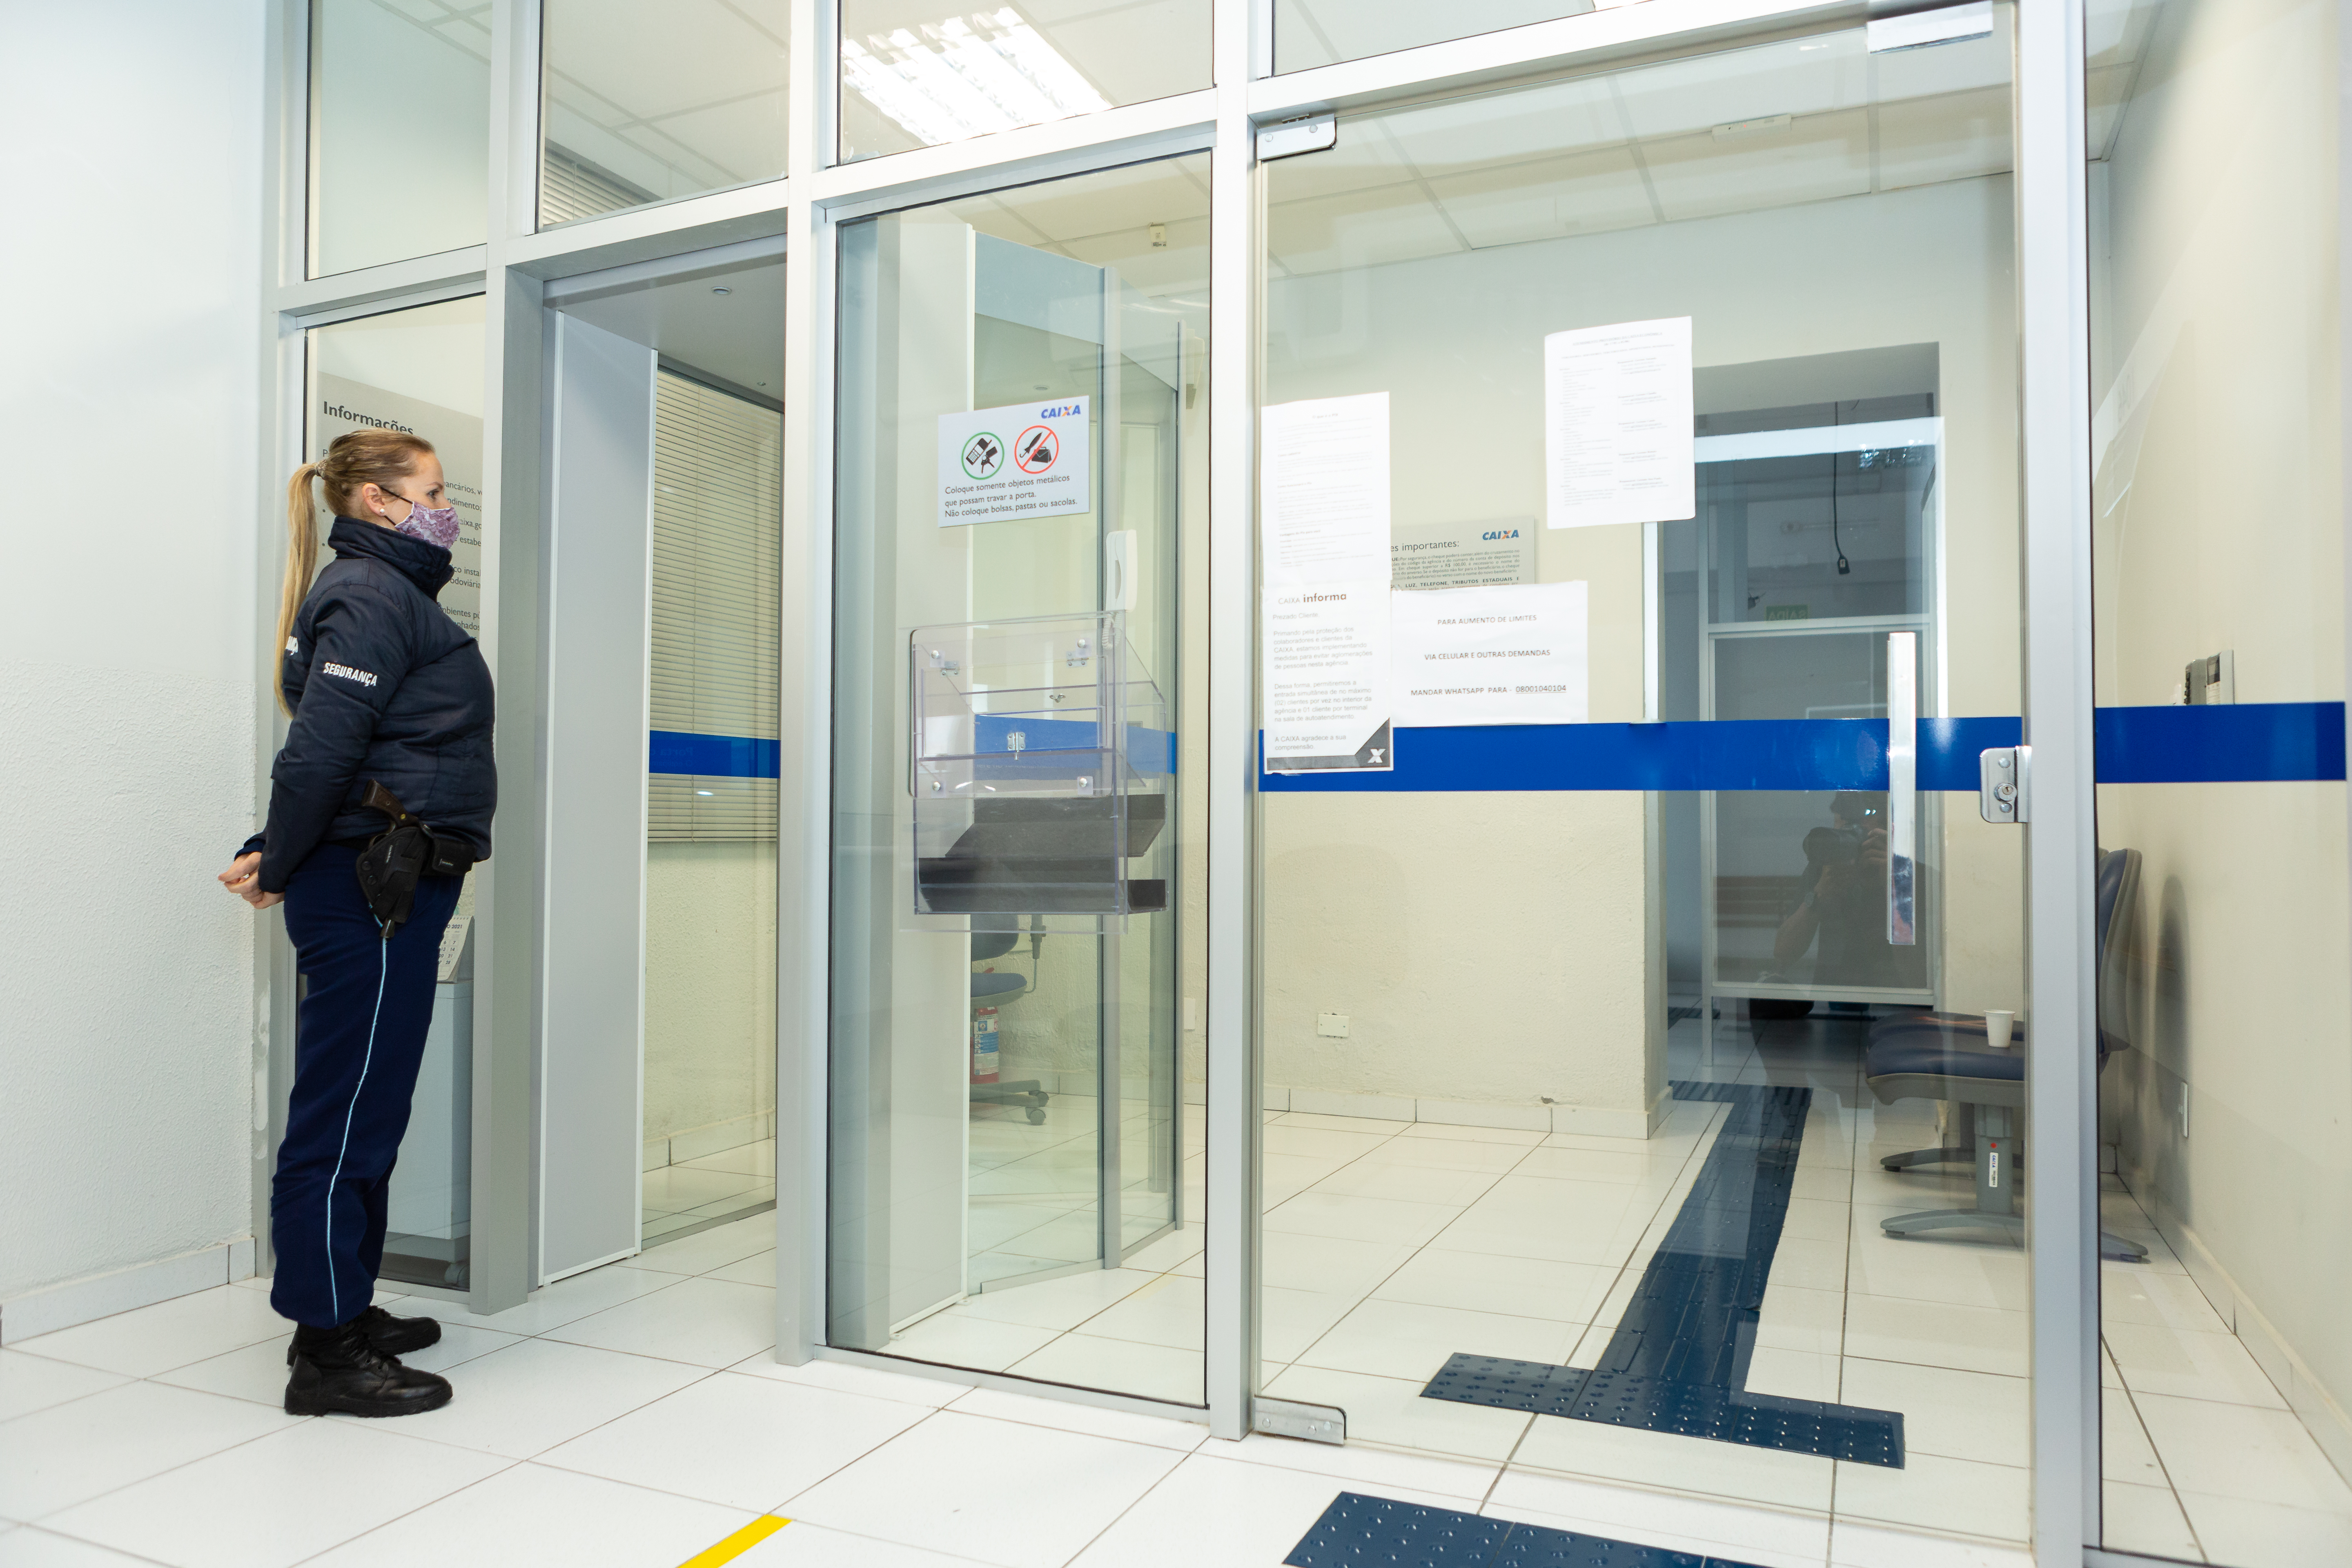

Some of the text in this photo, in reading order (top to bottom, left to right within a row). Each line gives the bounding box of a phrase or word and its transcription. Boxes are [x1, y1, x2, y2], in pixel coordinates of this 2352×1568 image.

[1041, 405, 1080, 419] CAIXA
[444, 481, 476, 494] ancários,
[1008, 480, 1034, 488] objetos
[1037, 475, 1069, 484] metálicos
[447, 497, 482, 511] ndimento;
[960, 498, 984, 506] possam
[1016, 492, 1036, 501] porta.
[1016, 503, 1036, 512] pastas
[1051, 498, 1077, 506] sacolas.
[460, 537, 481, 546] estabe
[1483, 530, 1519, 540] CAIXA
[1402, 541, 1459, 552] importantes:
[450, 577, 481, 589] odoviária
[1304, 593, 1346, 602] informa
[323, 662, 378, 687] SEGURANÇA
